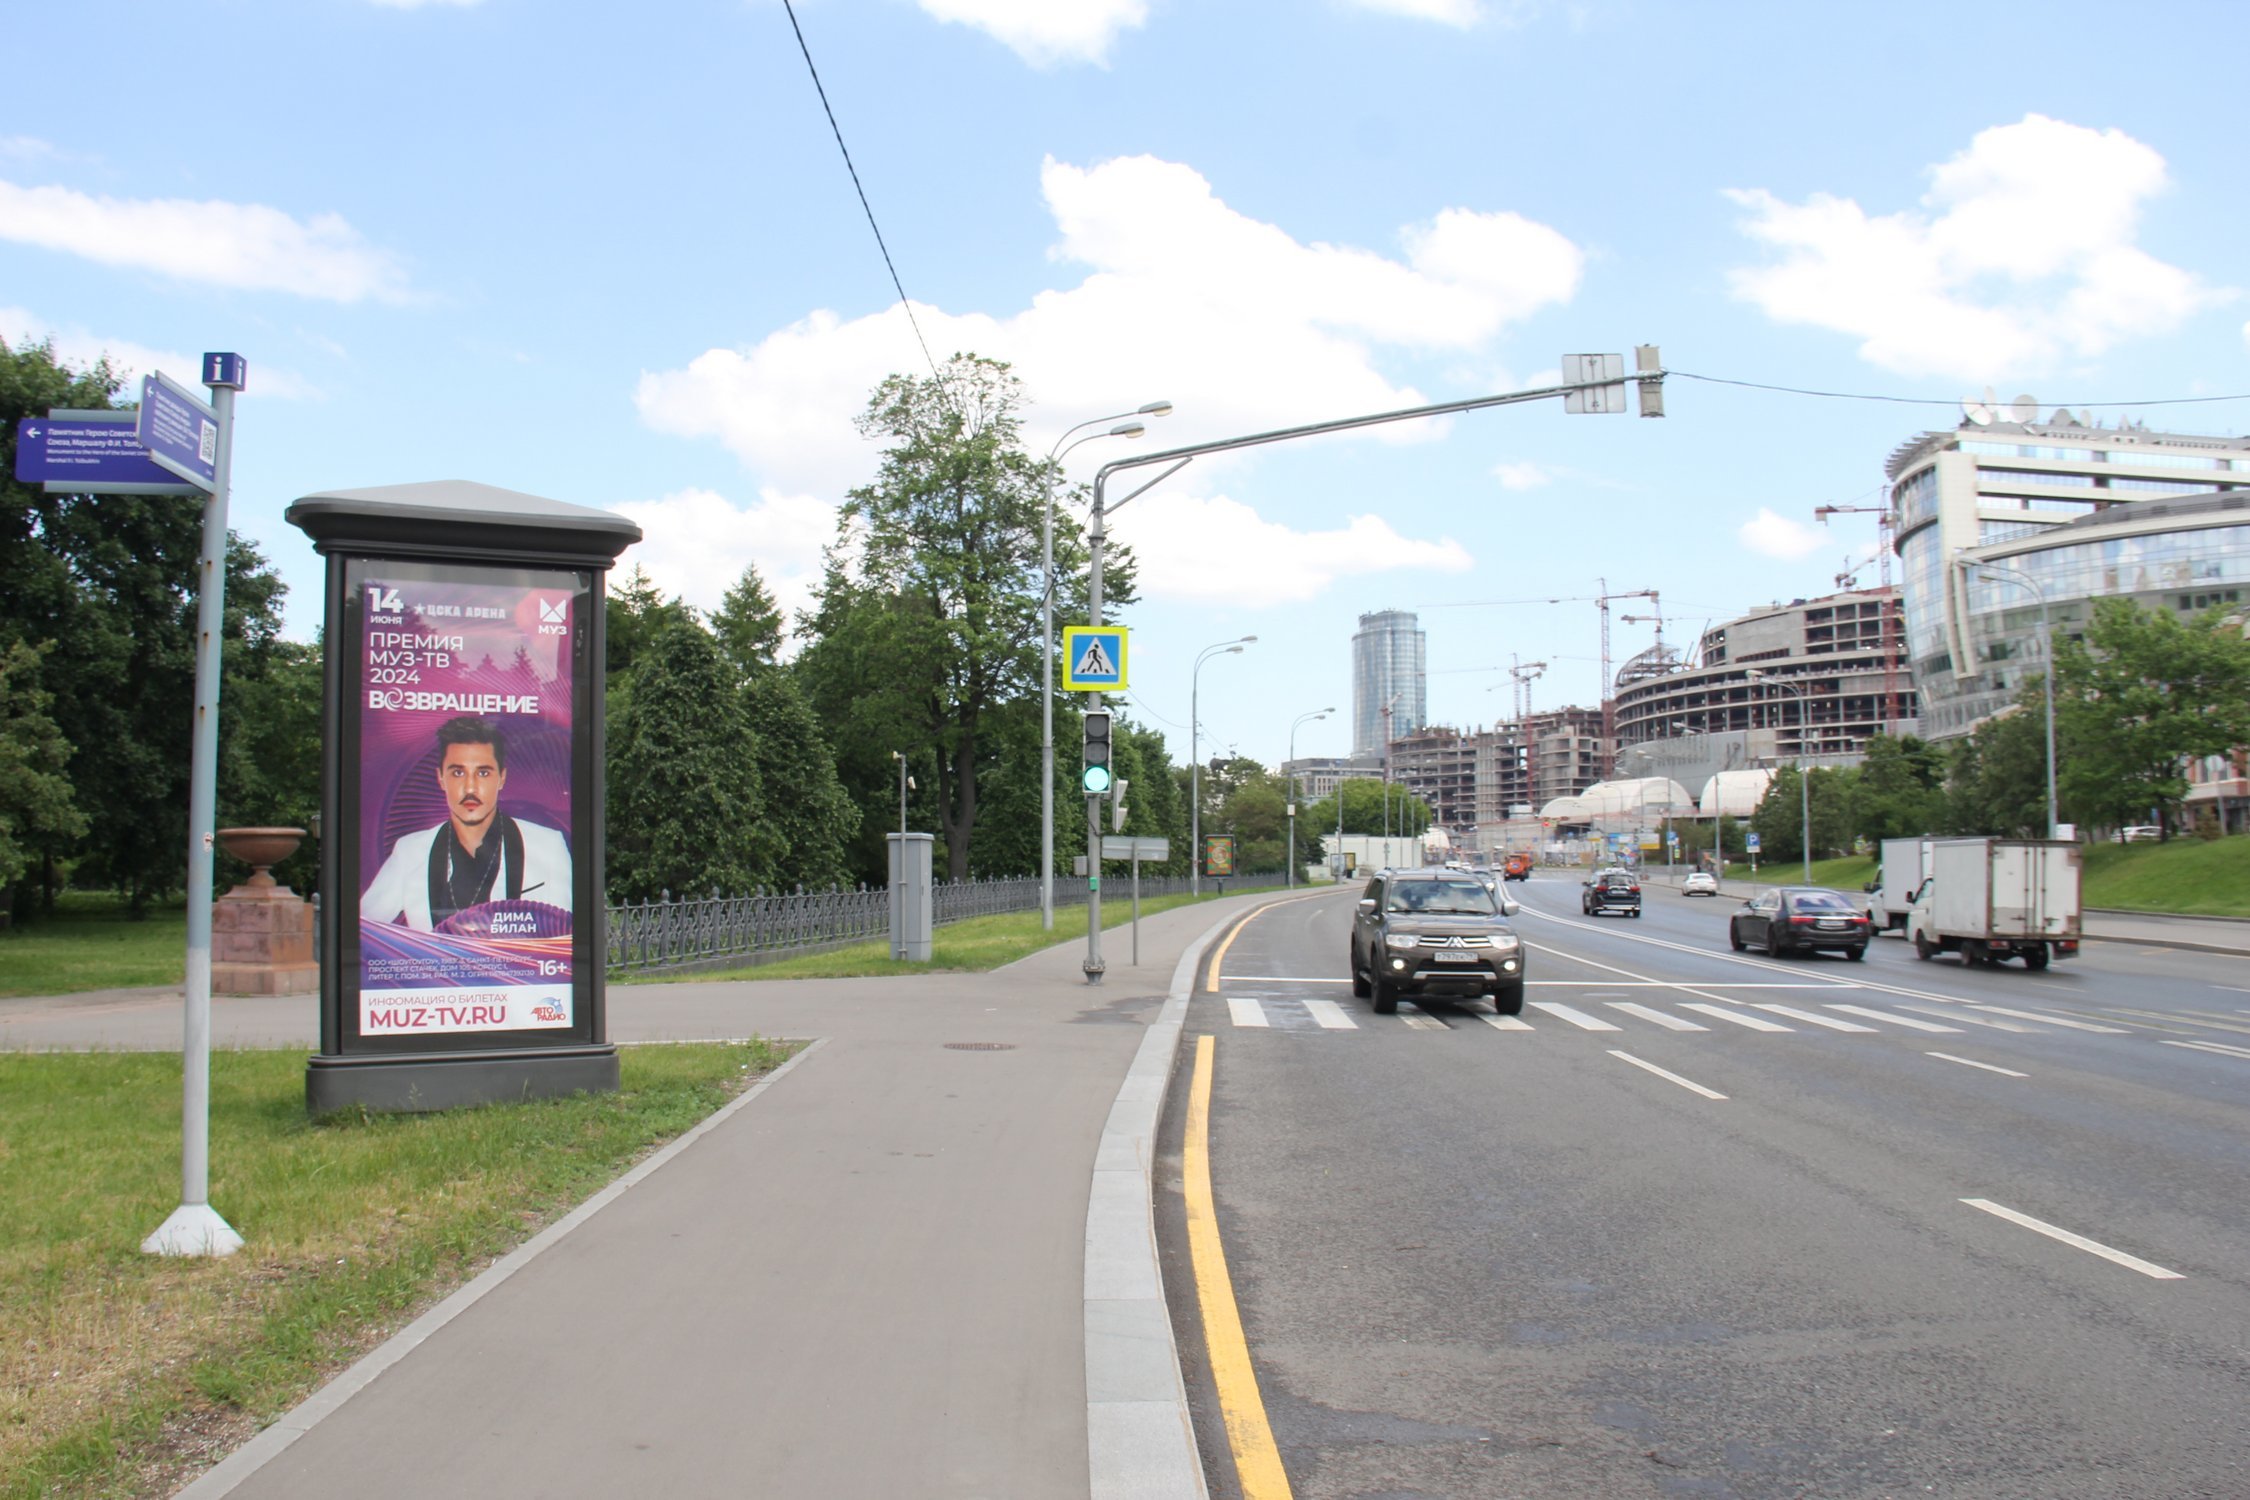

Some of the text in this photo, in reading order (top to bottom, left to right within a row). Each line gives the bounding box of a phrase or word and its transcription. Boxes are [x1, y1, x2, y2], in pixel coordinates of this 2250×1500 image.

[368, 587, 404, 614] 14
[370, 615, 402, 625] ИЮНЯ
[427, 604, 506, 620] ЦСКА АРЕНА
[538, 625, 567, 636] МУЗ
[370, 632, 464, 652] ПРЕМИЯ
[370, 650, 450, 668] МУЗ-ТВ
[370, 667, 421, 685] 2024
[369, 687, 539, 715] ВОЗВРАЩЕНИЕ
[492, 911, 534, 924] ДИМА
[490, 923, 537, 935] БИЛАН
[536, 959, 568, 977] 16+
[368, 993, 508, 1007] ИНФОМАЦИЯ О БИЛЕТАХ
[369, 1005, 507, 1029] MUZ-TV.RU
[537, 1013, 566, 1021] РАДИО
